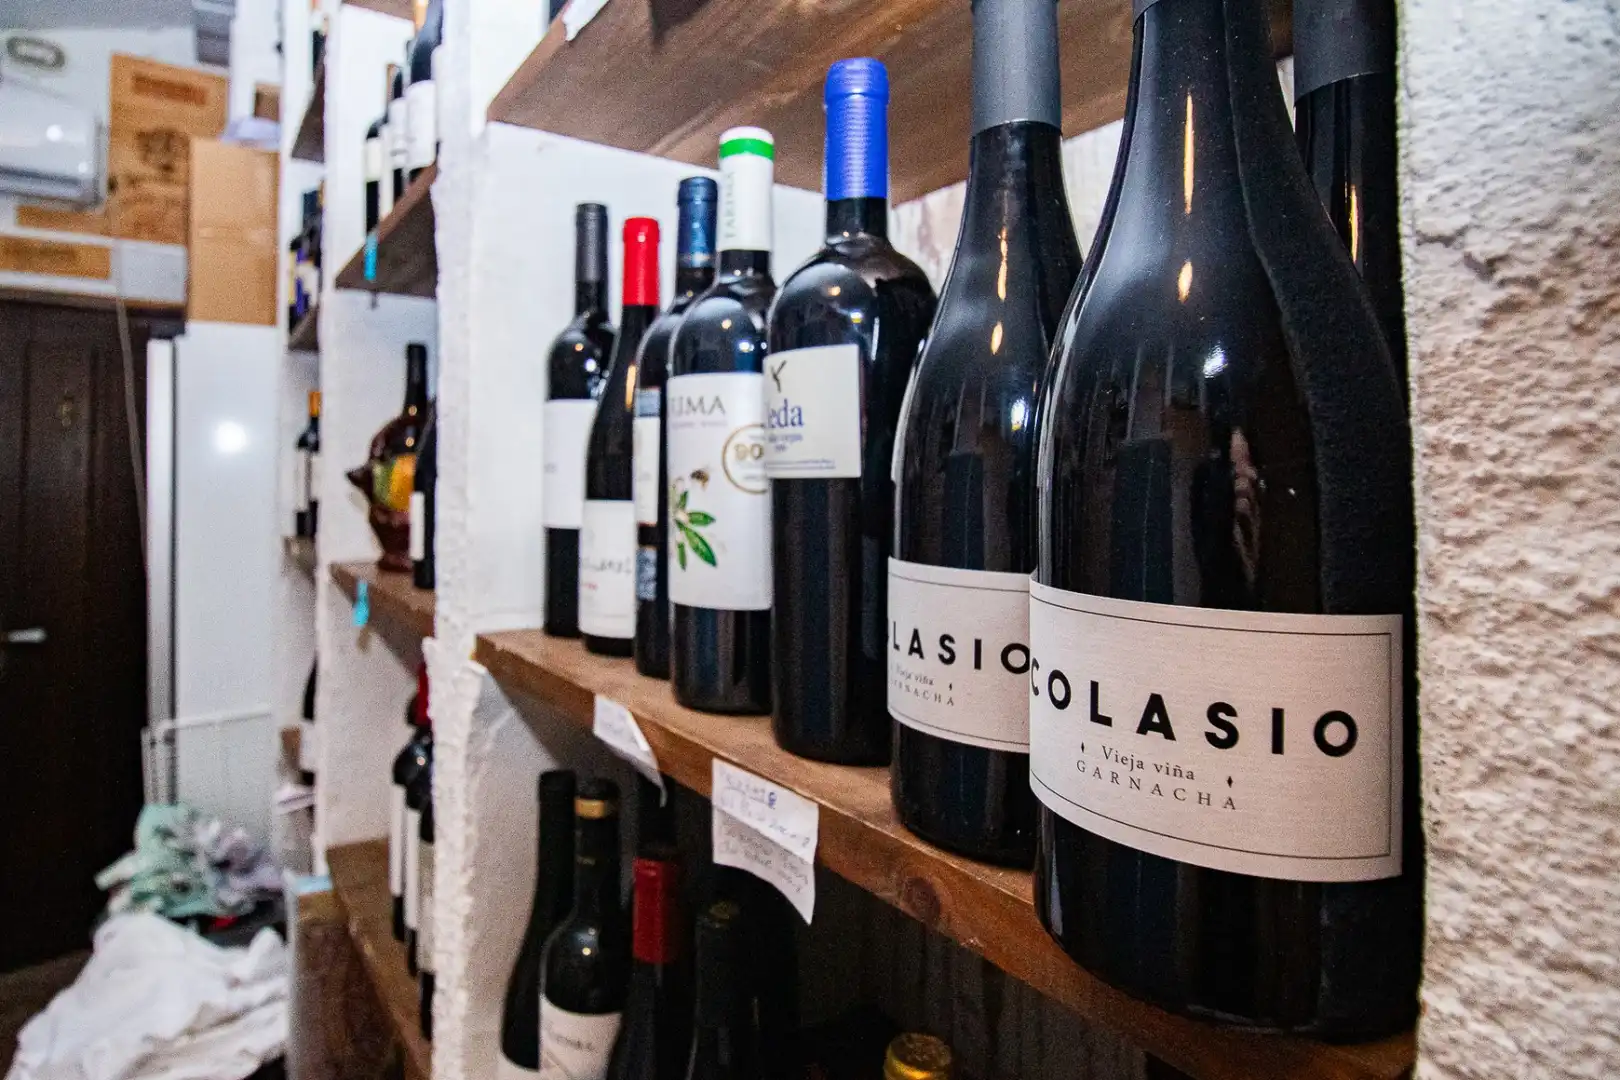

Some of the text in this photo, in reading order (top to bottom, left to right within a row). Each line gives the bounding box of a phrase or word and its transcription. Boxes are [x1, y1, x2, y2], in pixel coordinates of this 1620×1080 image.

[1030, 656, 1359, 758] COLASIO
[1076, 759, 1238, 811] GARNACHA
[1101, 744, 1196, 782] Vieja viña
